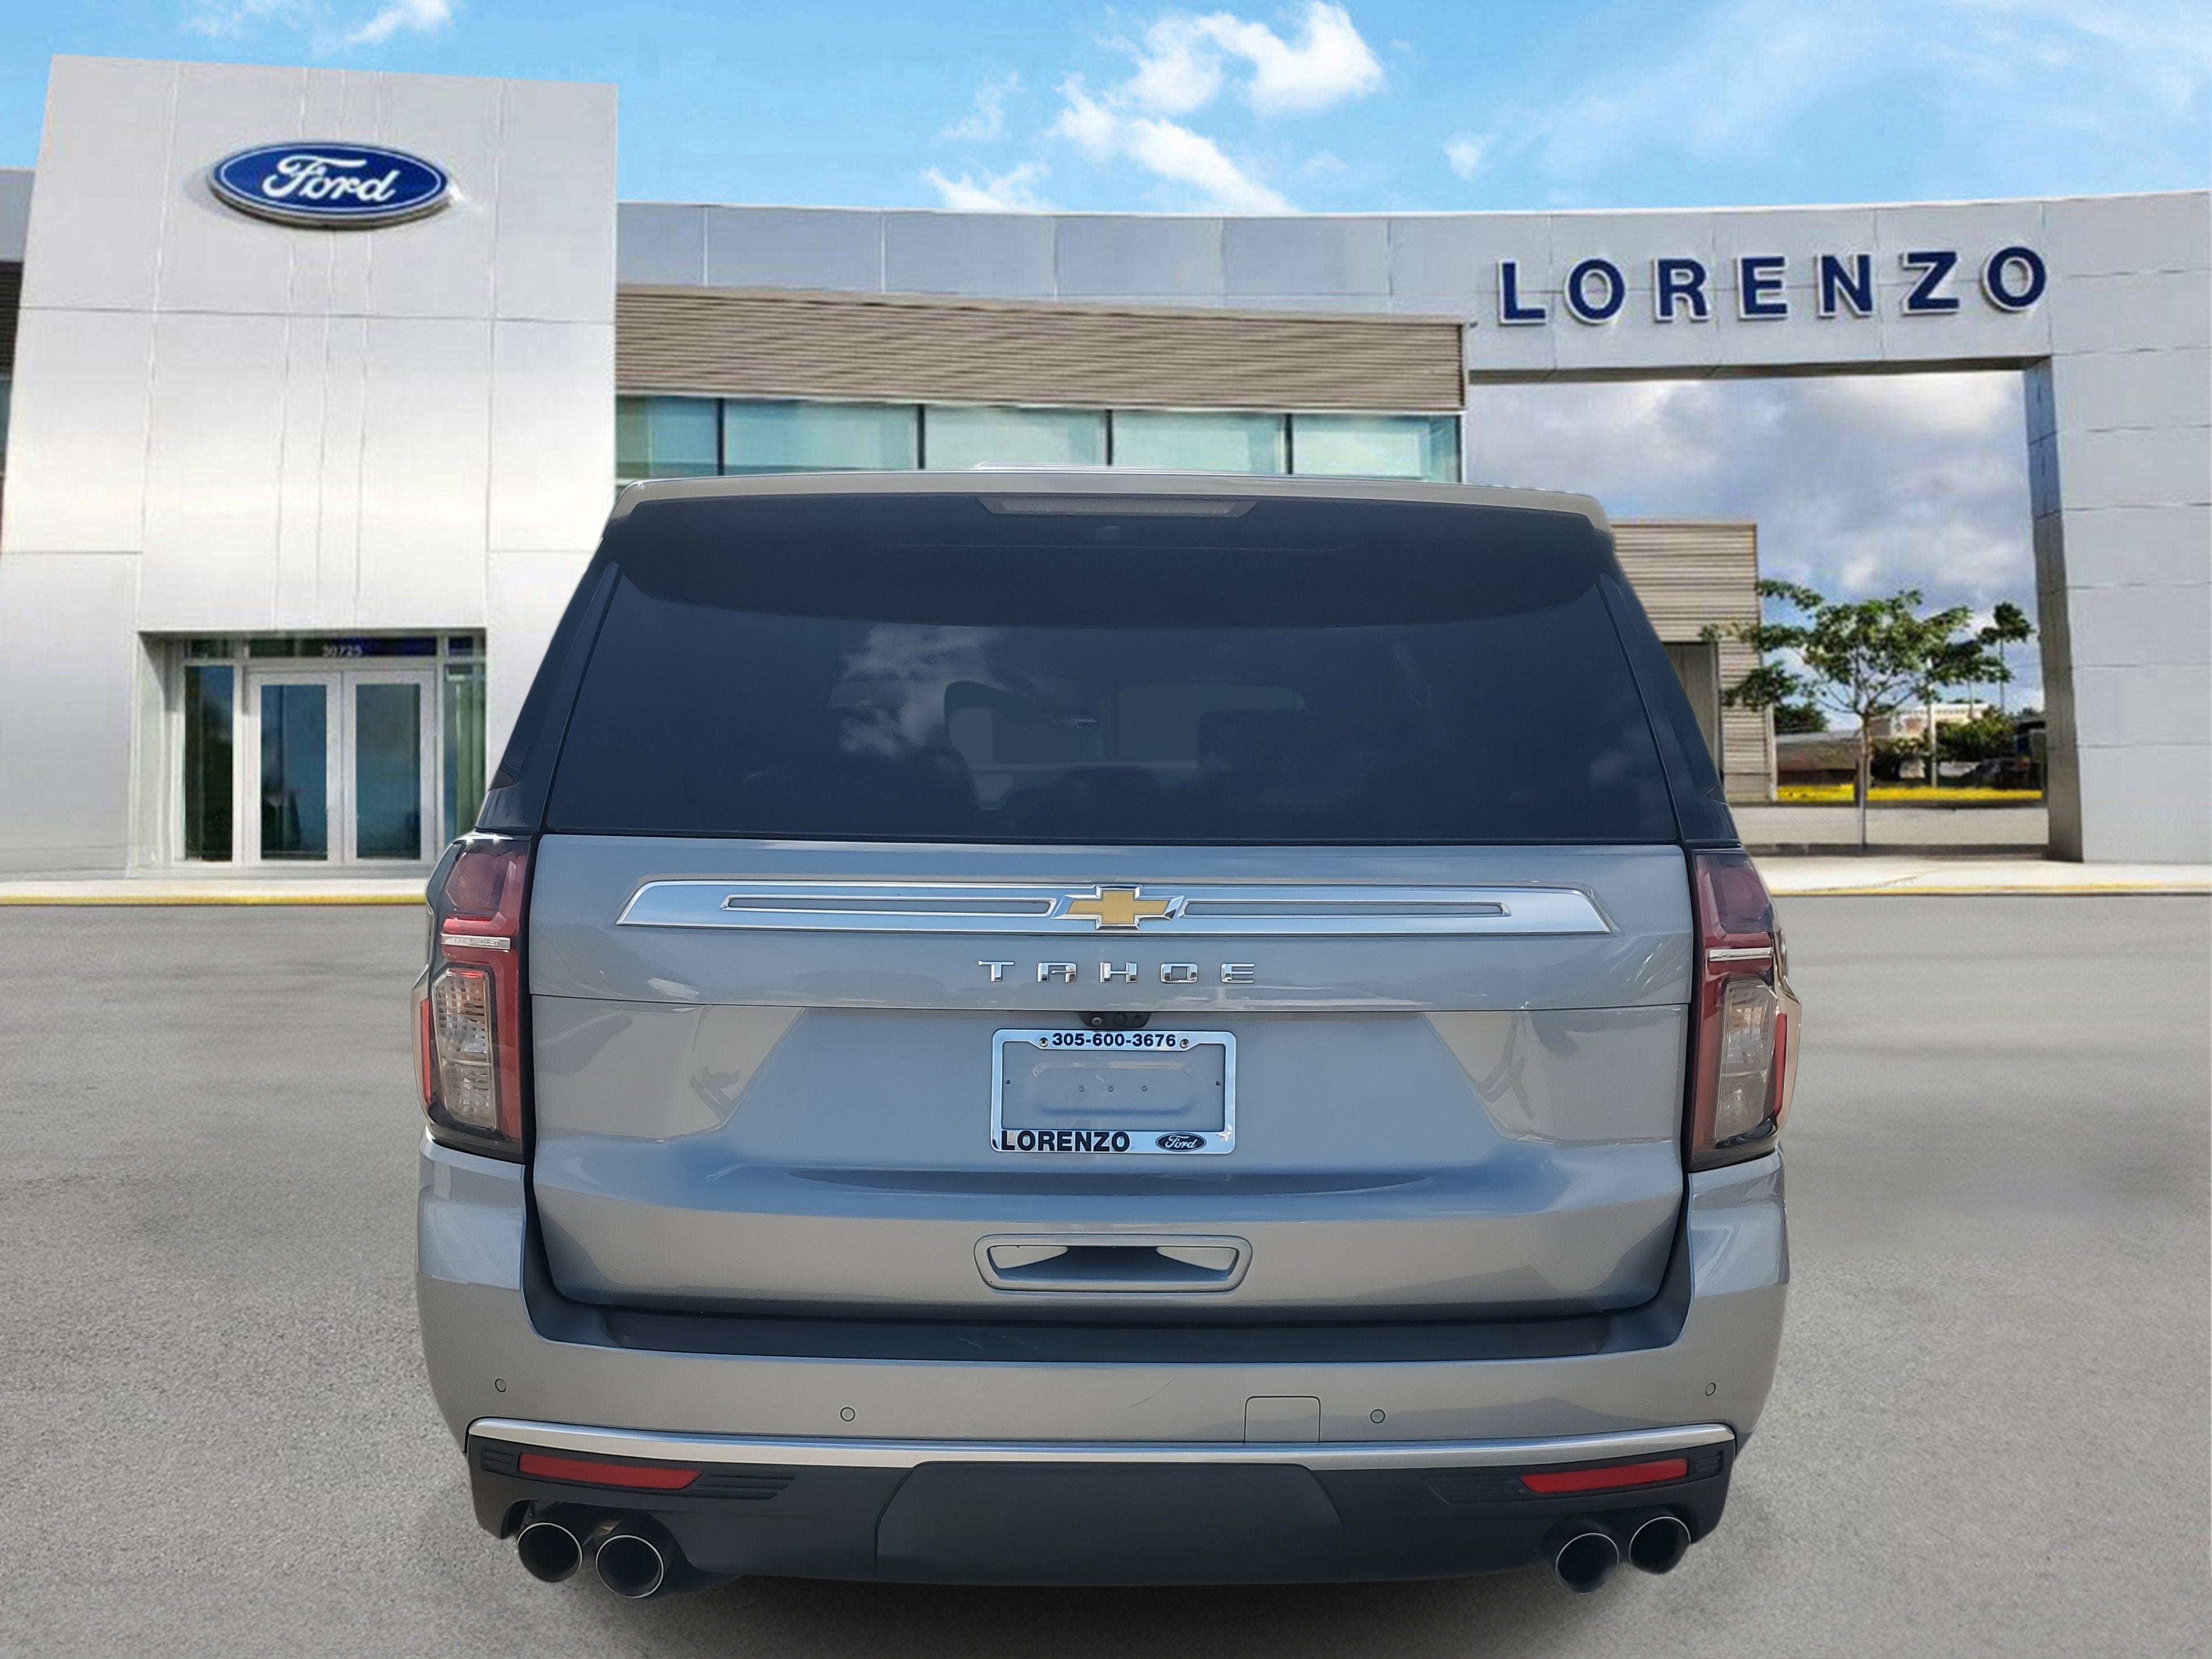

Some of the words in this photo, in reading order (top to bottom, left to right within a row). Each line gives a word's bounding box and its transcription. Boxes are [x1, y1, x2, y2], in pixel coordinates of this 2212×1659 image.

[262, 154, 400, 201] Ford
[1498, 246, 2046, 325] LORENZO
[978, 961, 1255, 984] TAHOE
[1052, 1033, 1177, 1047] 305-600-3676
[1001, 1130, 1130, 1152] LORENZO
[1165, 1135, 1198, 1149] Ford
